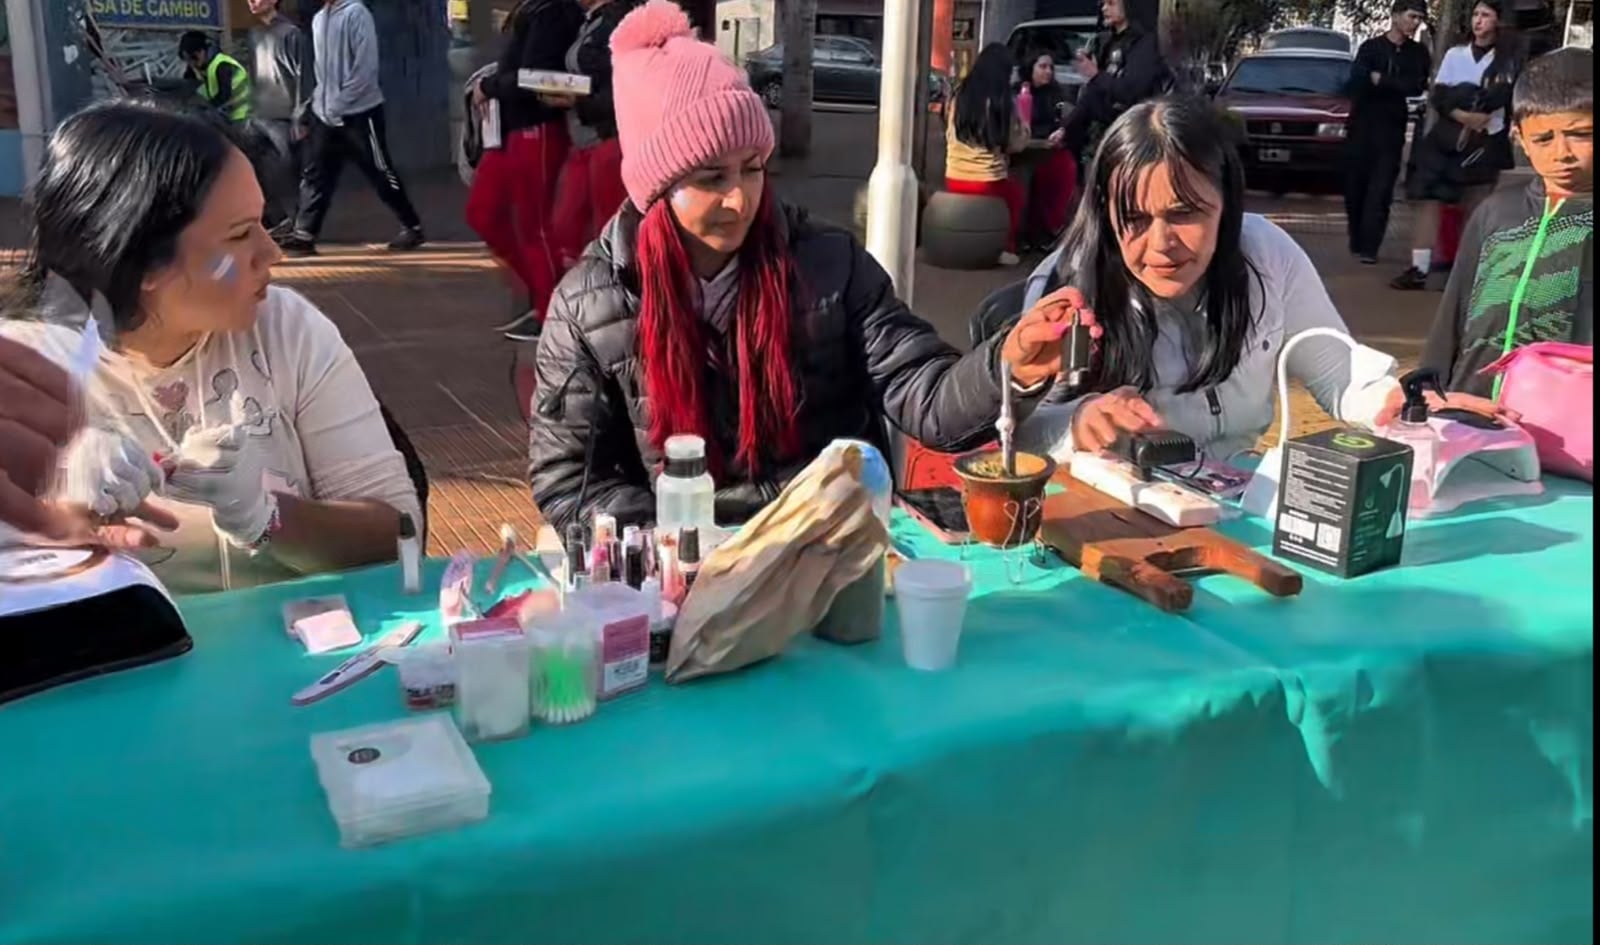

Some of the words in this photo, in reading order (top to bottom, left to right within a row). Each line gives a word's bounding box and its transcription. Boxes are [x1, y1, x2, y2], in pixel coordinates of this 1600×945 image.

[94, 0, 118, 15] SA
[120, 0, 144, 16] DE
[146, 0, 211, 18] CAMBIO
